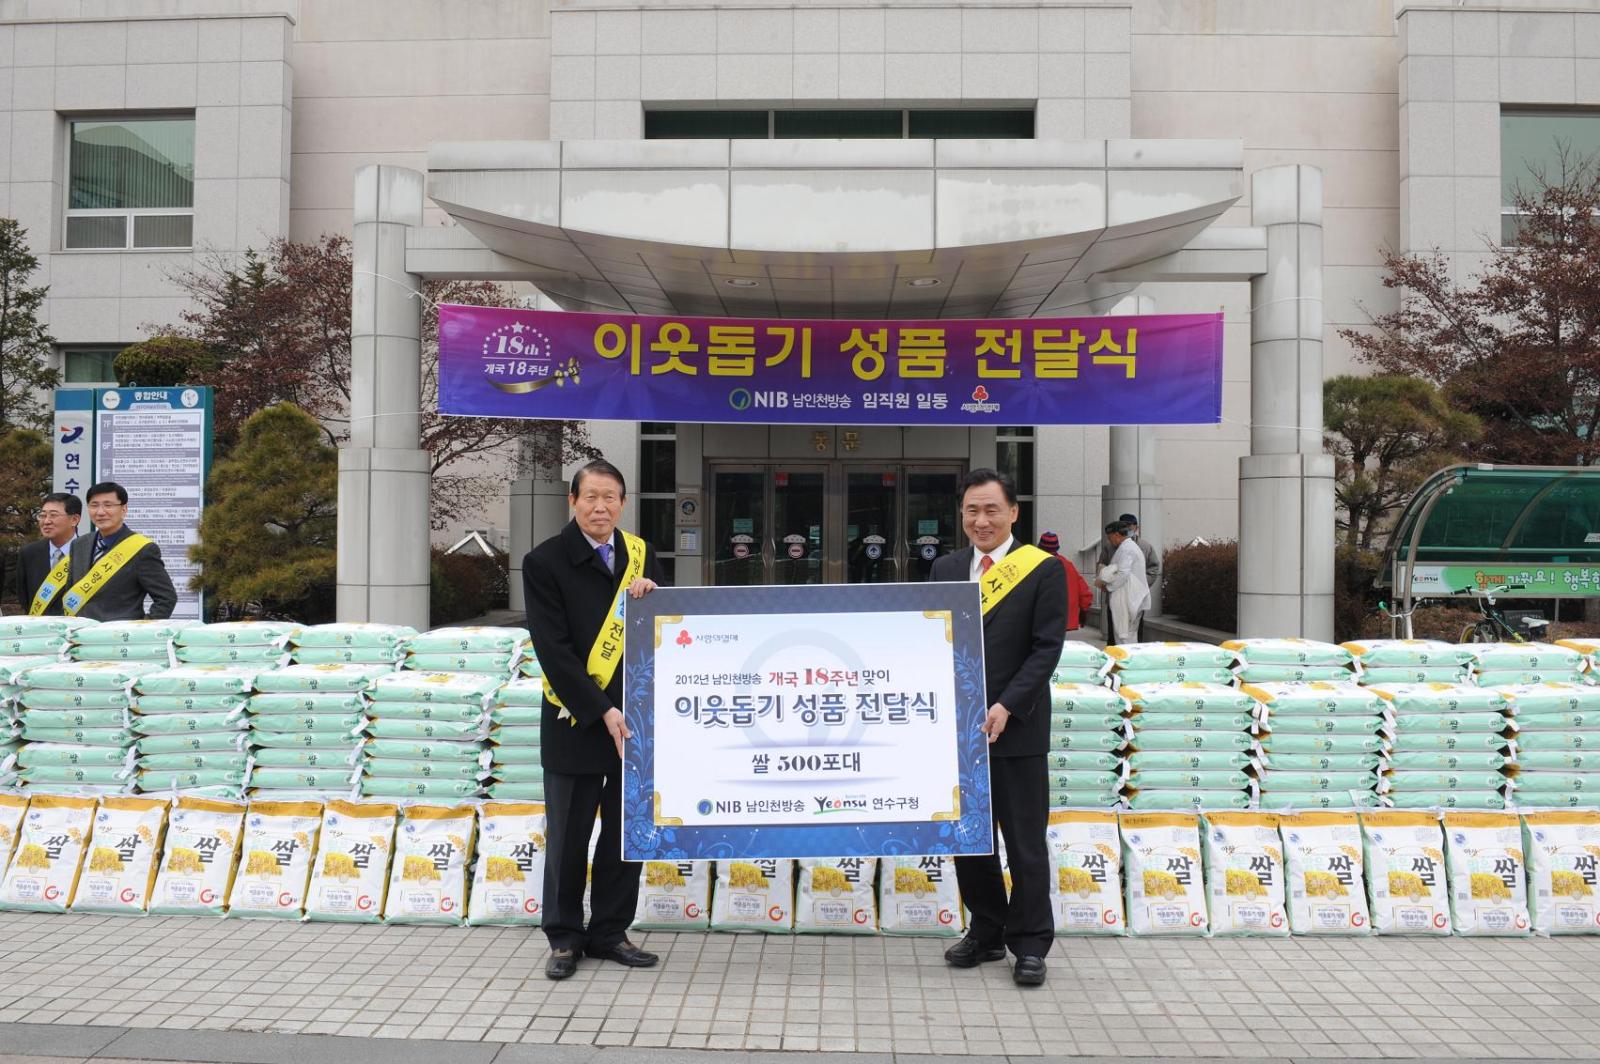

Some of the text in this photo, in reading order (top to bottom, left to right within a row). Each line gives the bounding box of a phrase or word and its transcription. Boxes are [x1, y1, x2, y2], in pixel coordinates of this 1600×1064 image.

[495, 335, 539, 356] 18th
[593, 322, 1138, 381] 이웃돕기 성품 전달식
[484, 361, 549, 376] 개국 18주년
[754, 391, 949, 410] NIB 남인천방송 임직원 일동
[675, 667, 890, 688] 2012년 남인천방송 개국 18주년 맞이
[674, 691, 937, 726] 이웃돕기 성품 전달식
[752, 752, 861, 774] 쌀 500포대
[716, 796, 919, 814] NIB 남인천방송 Yeonsu 연수구청
[43, 835, 70, 860] 쌀
[115, 834, 141, 863] 쌀
[194, 837, 221, 863] 쌀
[271, 840, 298, 866] 쌀
[349, 843, 376, 869] 쌀
[427, 843, 455, 871] 쌀
[510, 842, 537, 872] 쌀
[836, 858, 864, 882] 쌀
[918, 856, 945, 883] 쌀
[1082, 854, 1108, 883] 쌀
[1166, 856, 1193, 885] 쌀
[1249, 855, 1274, 886] 쌀
[1328, 855, 1354, 885] 쌀
[1411, 857, 1437, 886] 쌀
[1493, 857, 1519, 888] 쌀
[1574, 855, 1599, 885] 쌀
